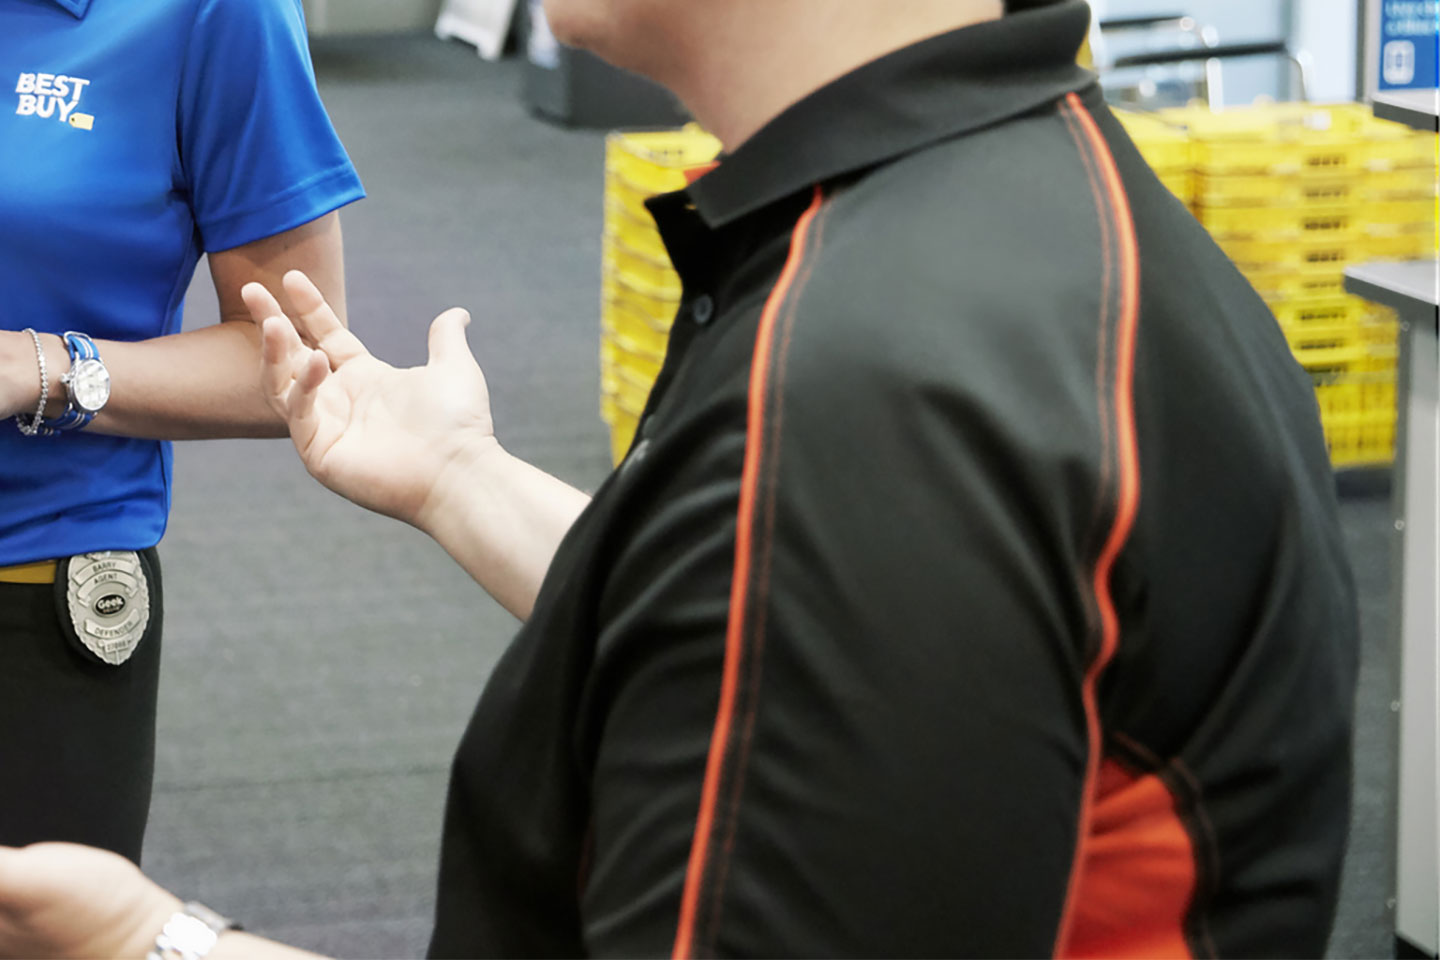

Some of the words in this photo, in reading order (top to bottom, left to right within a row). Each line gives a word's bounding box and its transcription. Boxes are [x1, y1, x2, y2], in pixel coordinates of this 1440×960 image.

[15, 72, 91, 102] BEST
[15, 94, 79, 123] BUY
[94, 573, 117, 583] AGENT
[97, 596, 123, 609] Geek
[94, 621, 133, 636] DEFENDER
